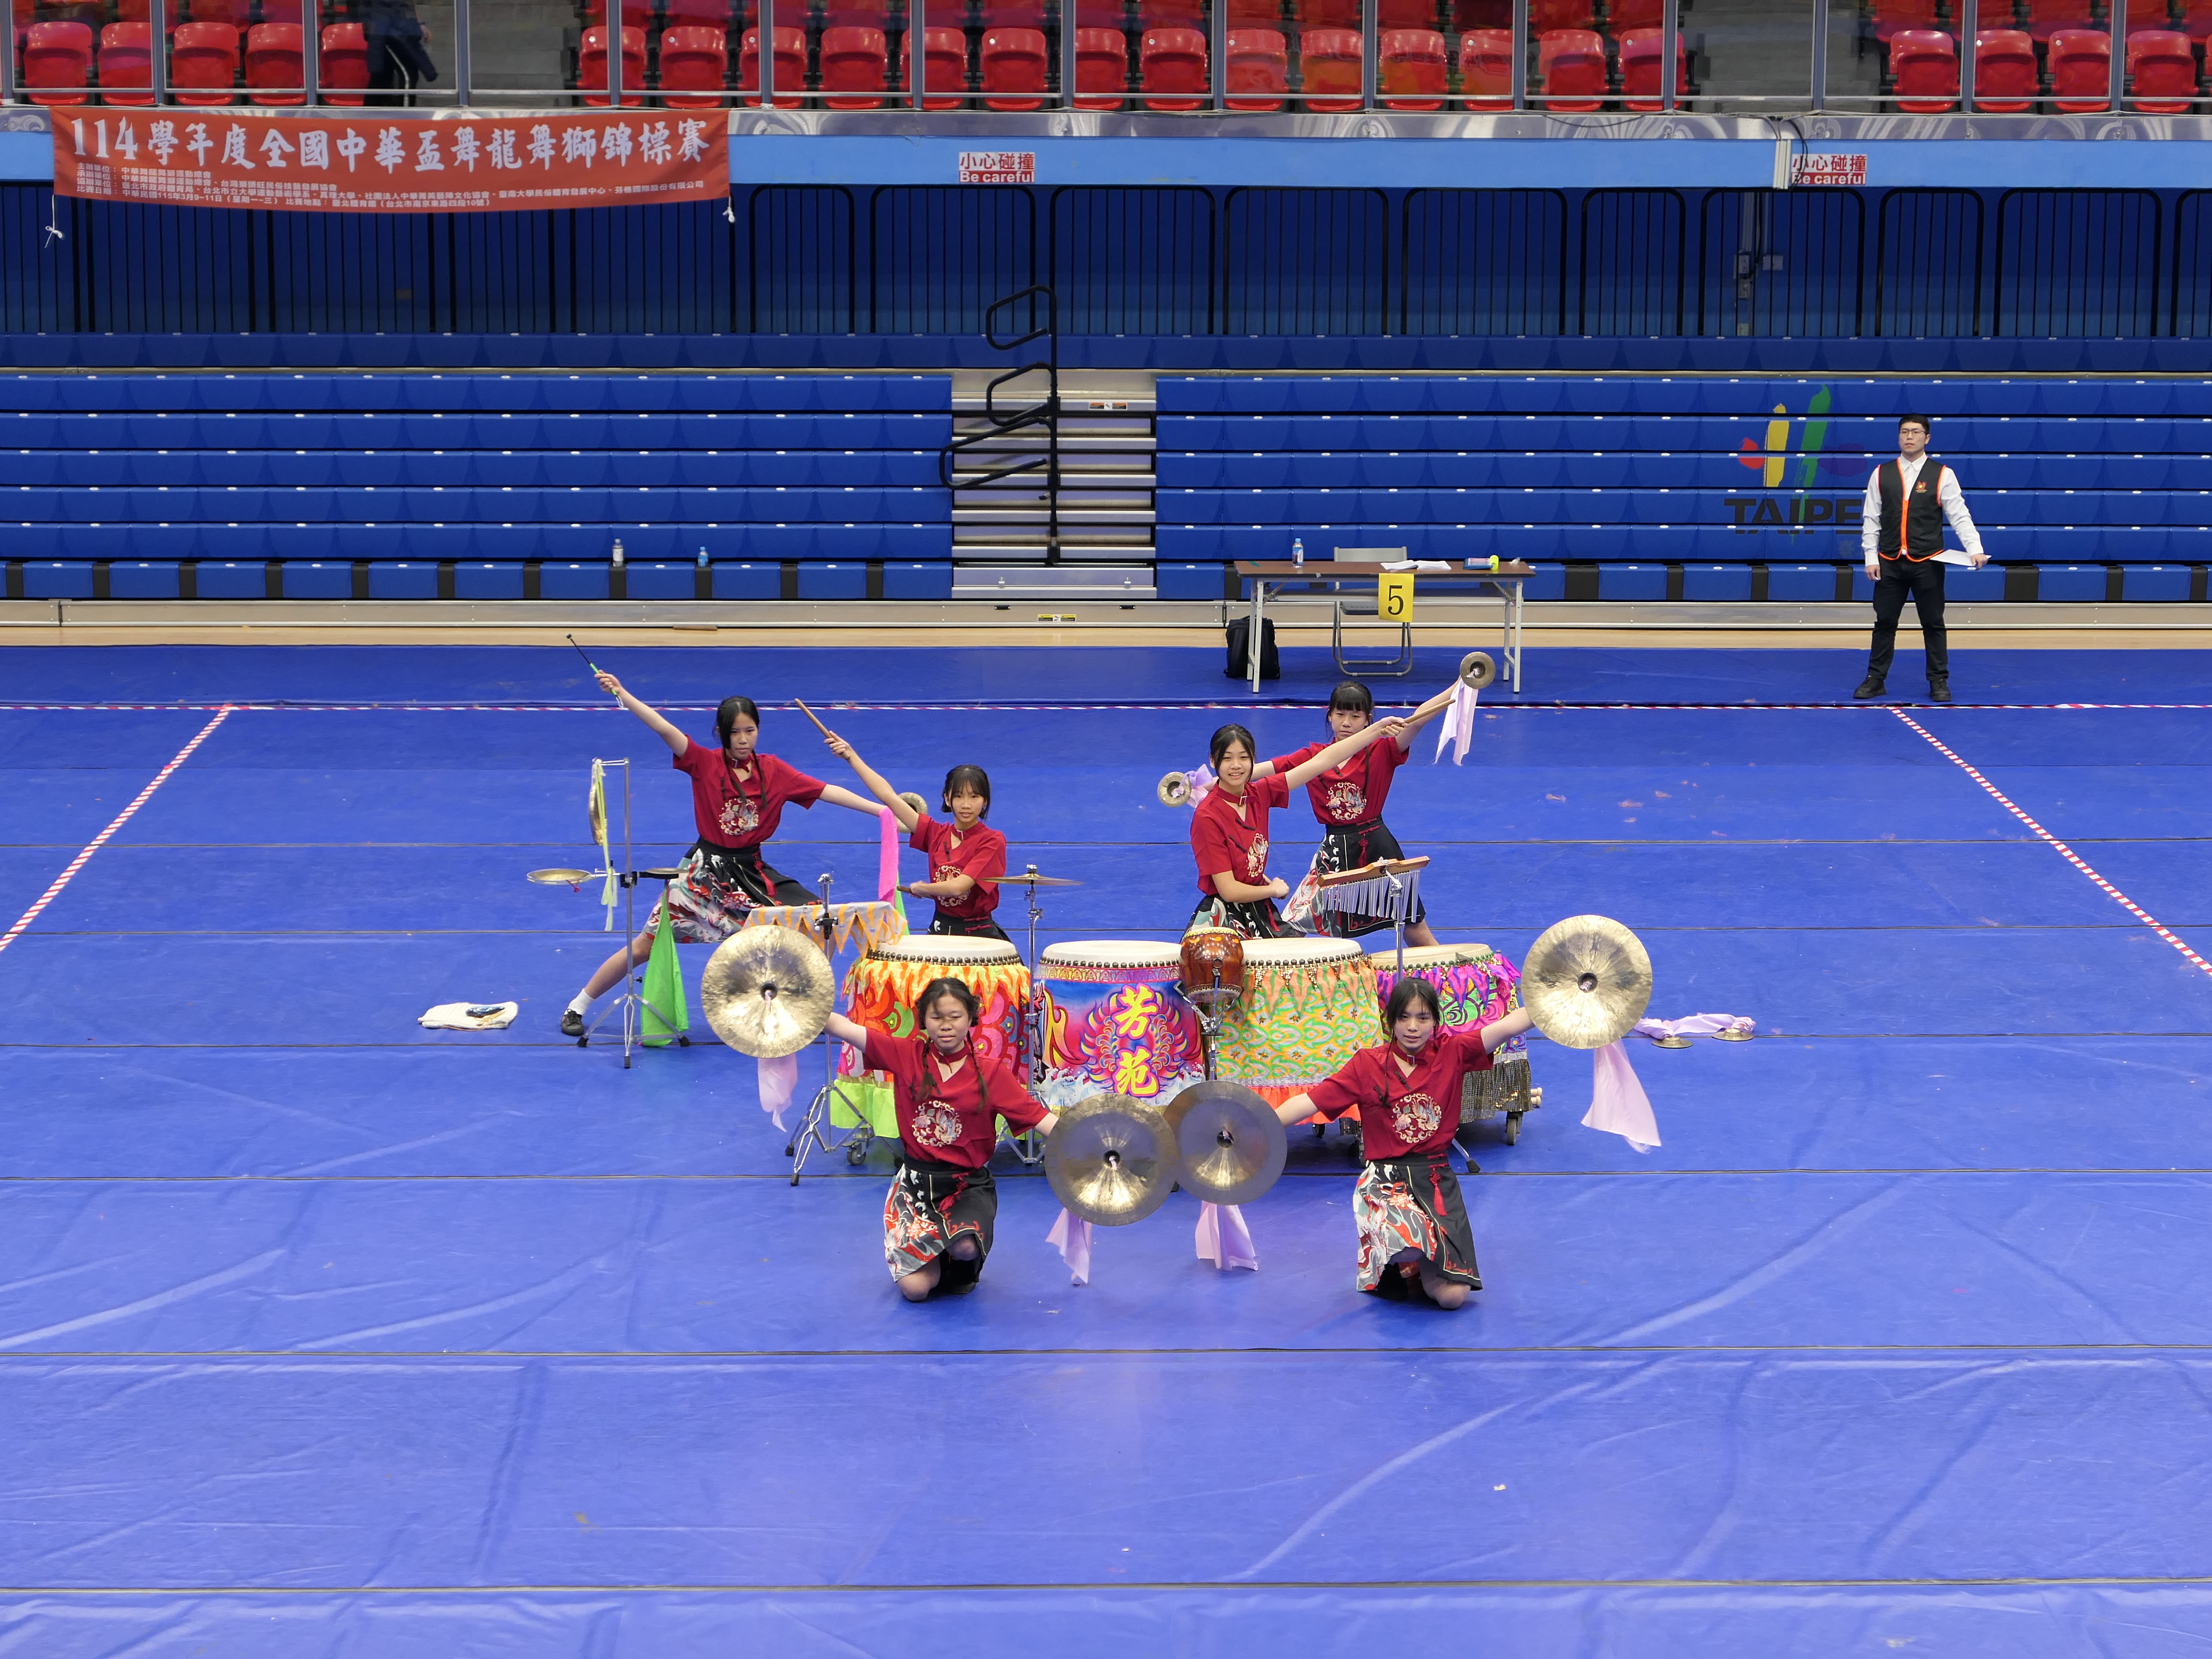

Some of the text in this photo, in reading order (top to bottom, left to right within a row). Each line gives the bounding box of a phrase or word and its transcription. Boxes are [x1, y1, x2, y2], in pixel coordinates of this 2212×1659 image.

[70, 116, 709, 173] 114學年度全國中華盃舞龍舞獅錦標賽
[960, 152, 1034, 170] 小心碰撞
[1792, 155, 1866, 171] 小心碰撞
[960, 171, 1034, 182] Be careful
[1814, 173, 1865, 184] careful
[1724, 498, 1864, 534] TAIPE
[1388, 585, 1403, 615] 5
[1114, 983, 1159, 1096] 芳苑
